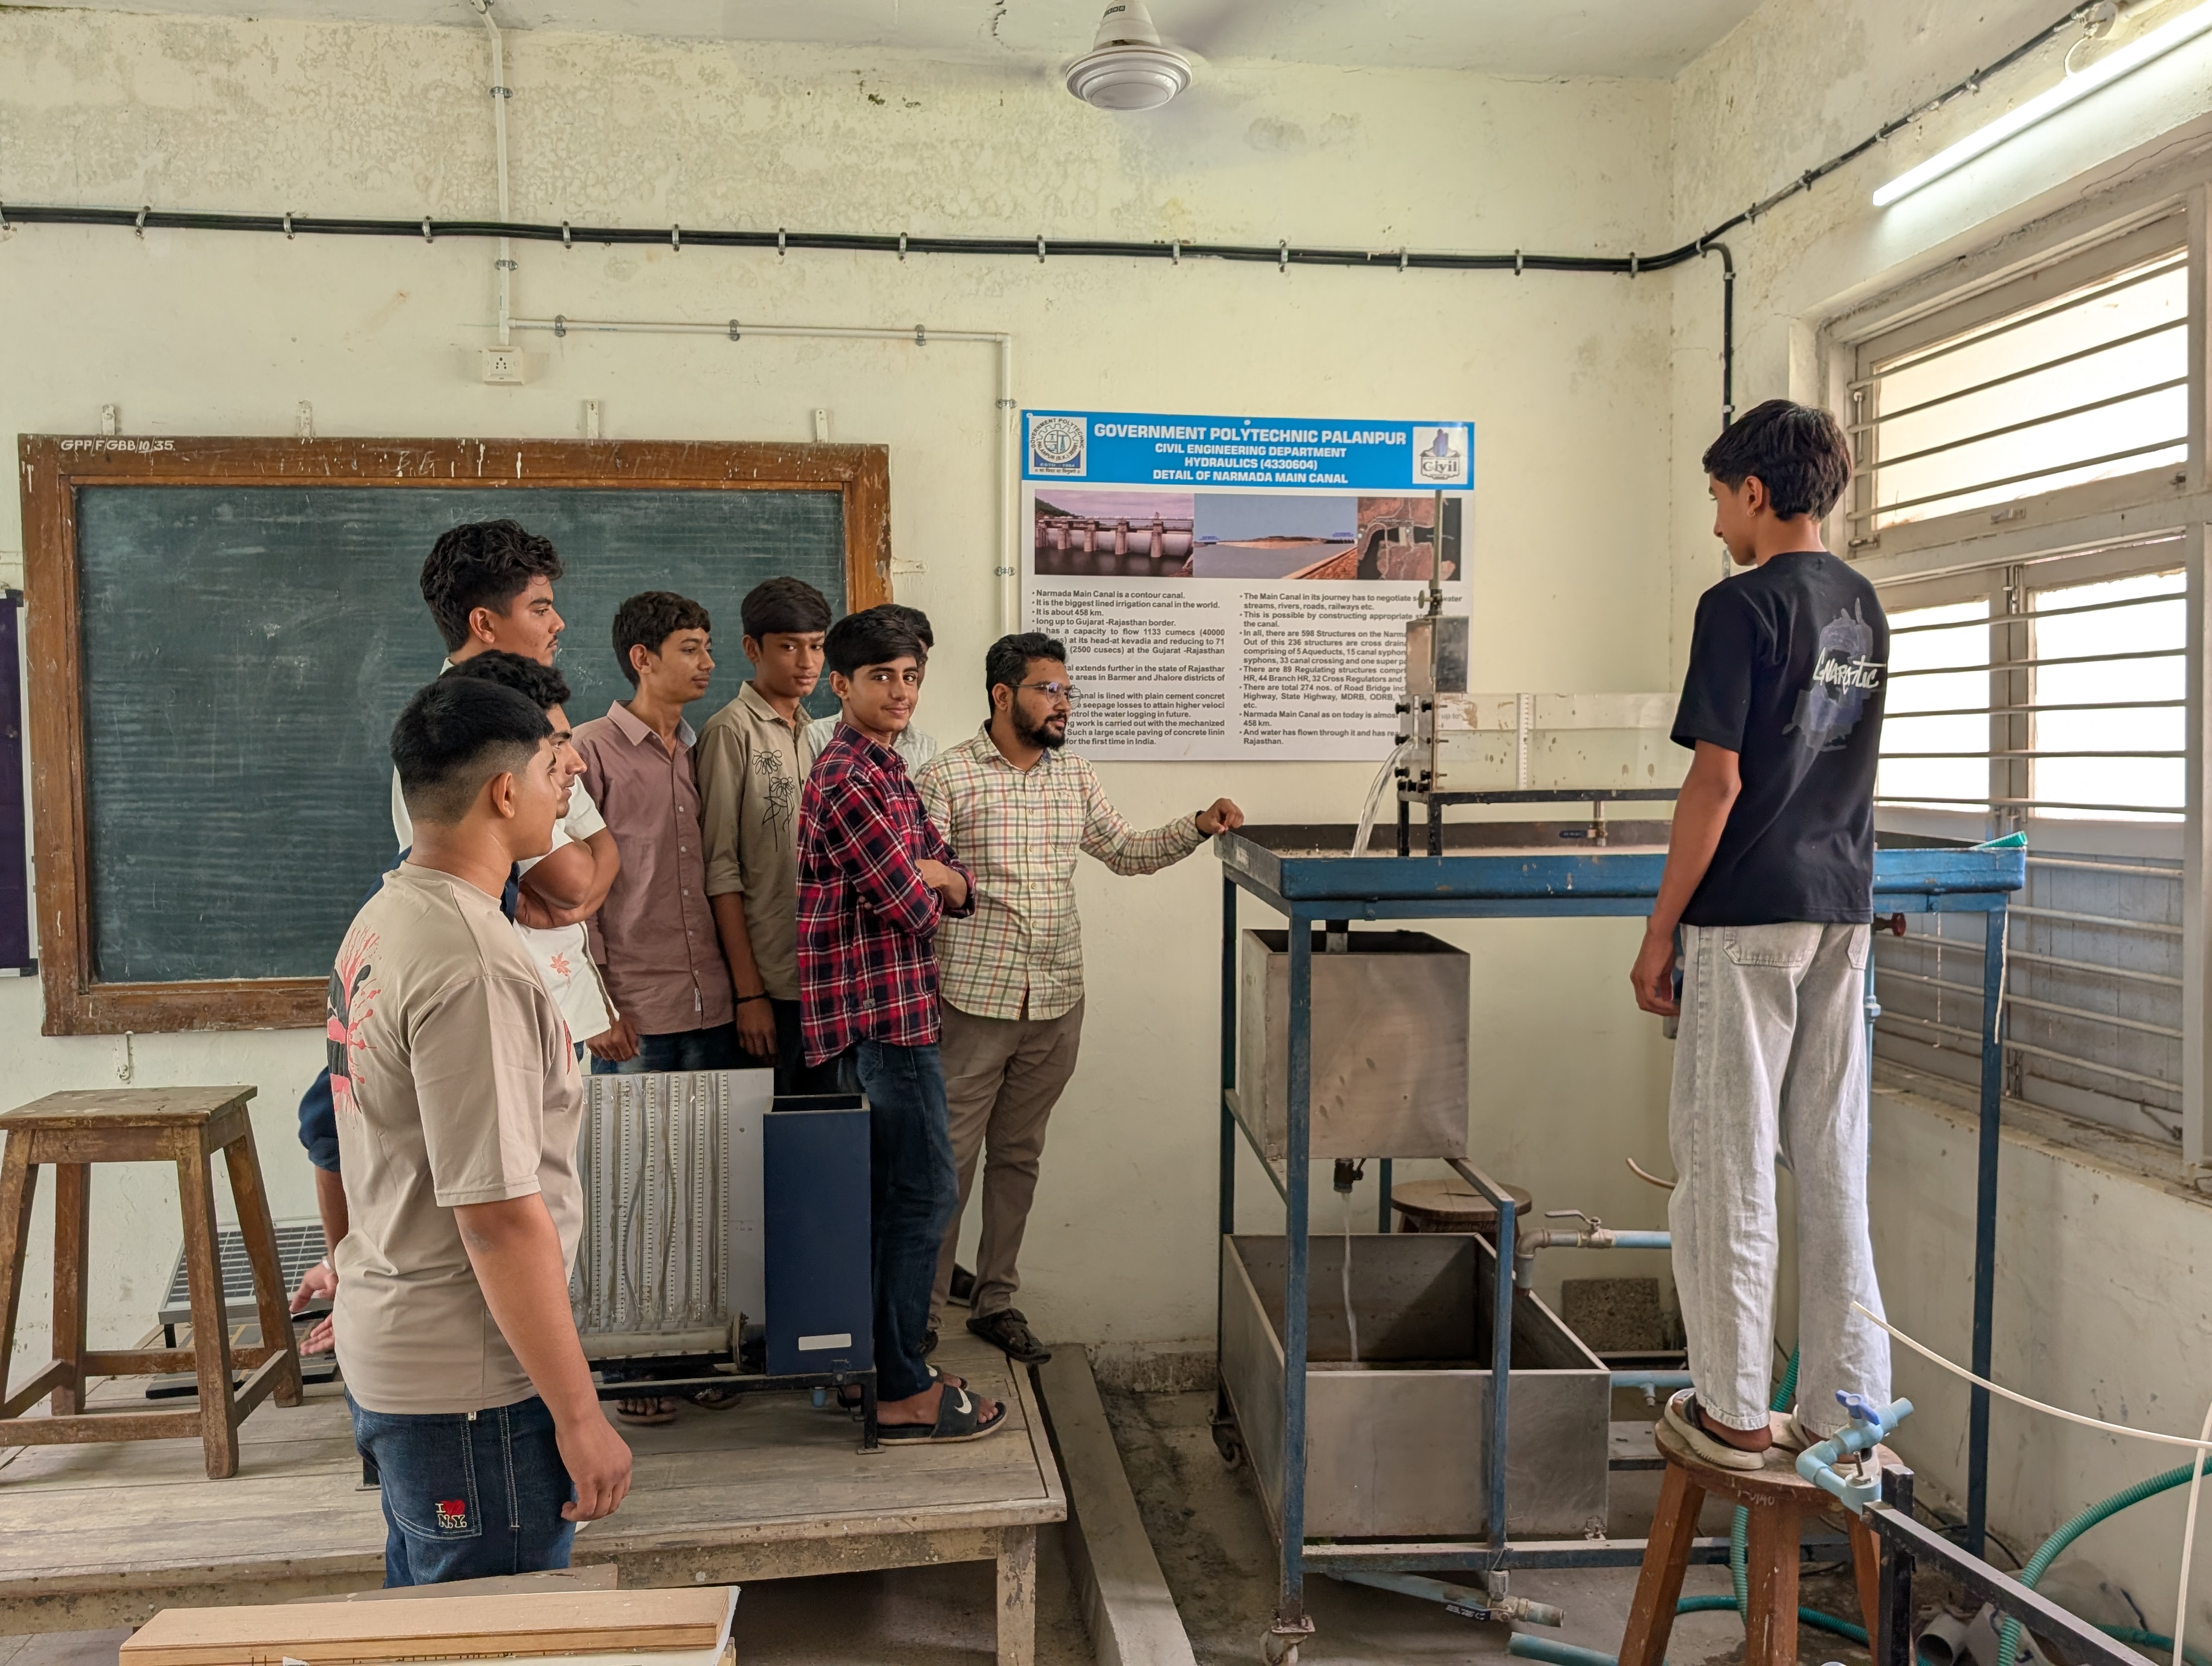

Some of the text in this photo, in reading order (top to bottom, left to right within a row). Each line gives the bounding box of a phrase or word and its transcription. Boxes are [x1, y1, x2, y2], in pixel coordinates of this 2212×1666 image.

[1031, 418, 1056, 448] GOVERNMENT
[1094, 424, 1406, 445] GOVERNMENT POLYTECHNIC PALANPUR
[1155, 443, 1347, 458] CIVIL ENGINEERING DEPARTMENT
[1185, 457, 1318, 471] HYDRAULICS (4330604)
[1423, 460, 1458, 474] Civil
[1153, 469, 1348, 484] DETAIL OF NARMADA MAIN CANAL
[1322, 594, 1351, 602] journey
[1376, 594, 1411, 603] negotiate
[1064, 599, 1094, 607] biggest
[1115, 600, 1151, 608] irrigation
[1328, 603, 1360, 611] railways
[1307, 612, 1316, 620] by
[1036, 618, 1053, 626] long
[1076, 618, 1104, 626] Gujarat
[1106, 618, 1147, 627] -Rajasthan
[1073, 627, 1106, 636] capacity
[1200, 629, 1225, 637] (40000
[1169, 638, 1204, 646] reducing
[1070, 646, 1091, 654] (2500
[1094, 646, 1124, 655] cusecs)
[1152, 647, 1181, 655] Gujarat
[1184, 647, 1225, 655] -Rajasthan
[1346, 675, 1386, 683] Regulators
[1243, 693, 1278, 701] Highway,
[1303, 693, 1338, 701] Highway,
[1127, 710, 1156, 719] logging
[1343, 711, 1364, 719] today
[1320, 729, 1349, 737] through
[1243, 738, 1284, 746] Rajasthan.
[435, 1503, 446, 1513] I
